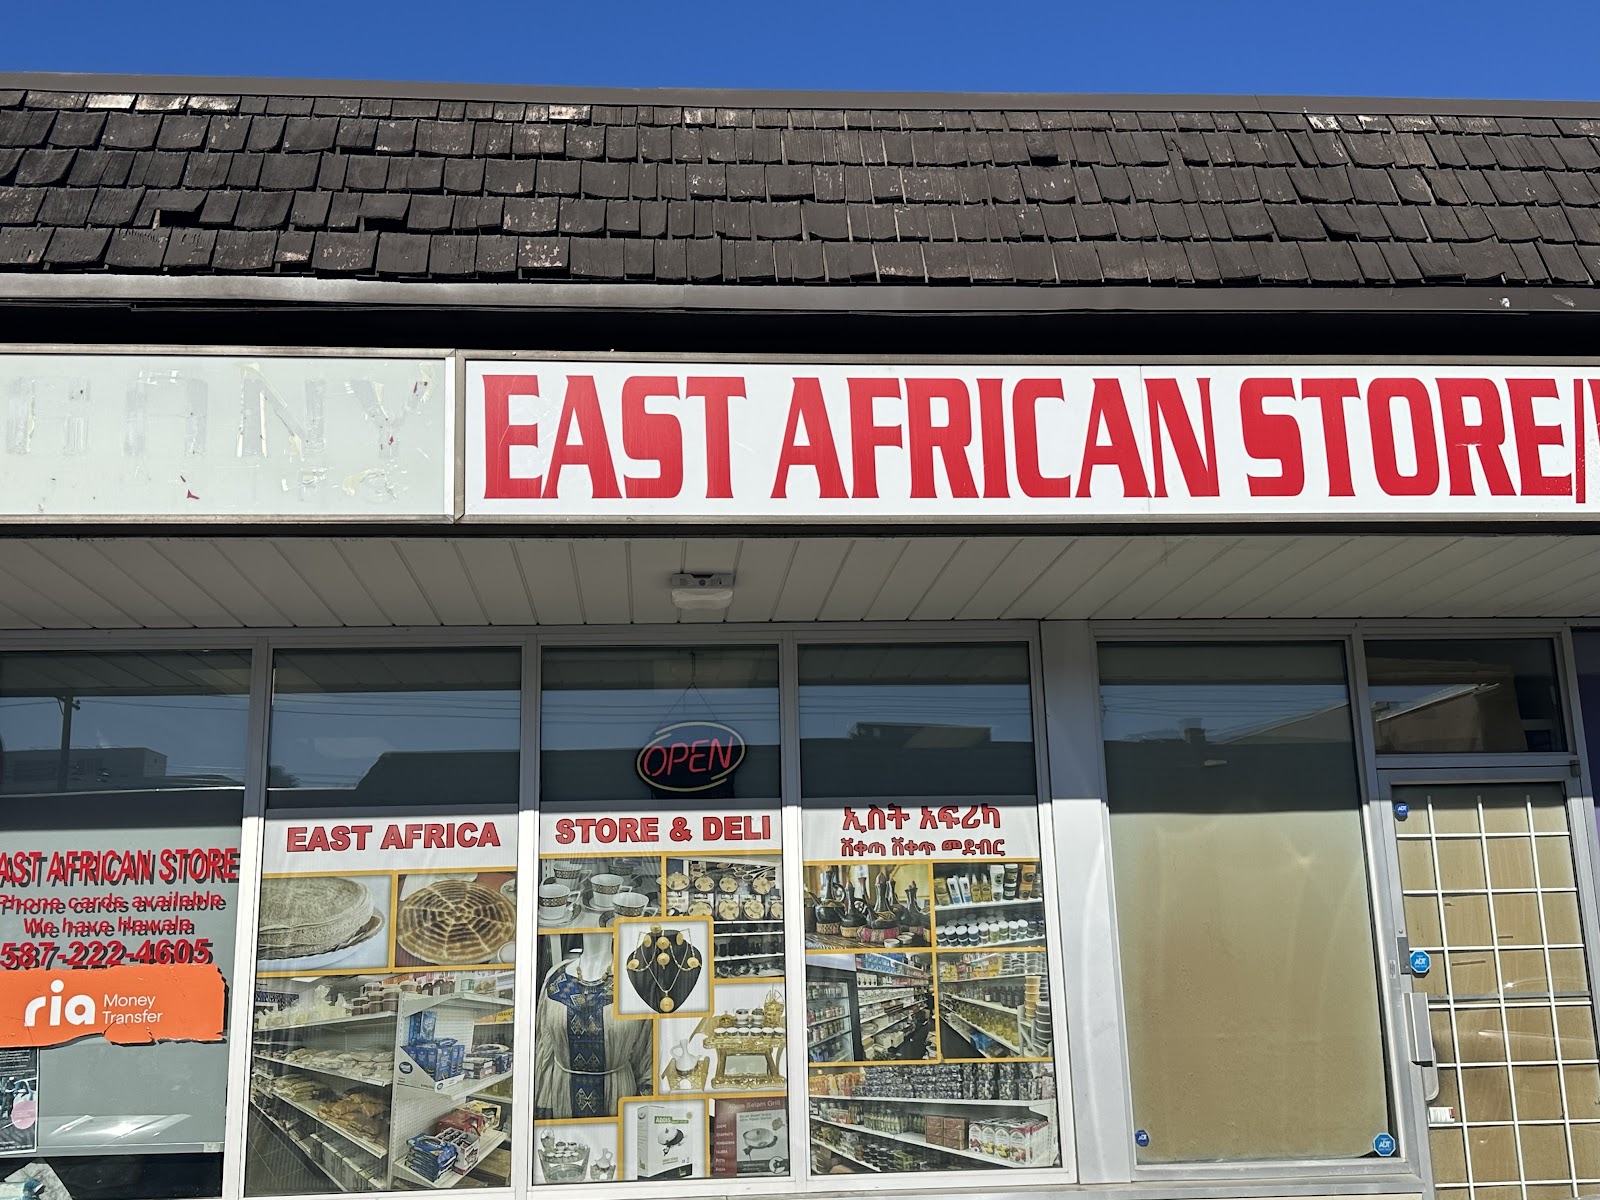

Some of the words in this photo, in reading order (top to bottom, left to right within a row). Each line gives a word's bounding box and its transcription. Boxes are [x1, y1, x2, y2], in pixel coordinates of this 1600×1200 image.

[483, 375, 746, 499] EAST
[771, 377, 1220, 498] AFRICAN
[643, 736, 734, 777] OPEN
[555, 817, 660, 844] STORE
[669, 816, 693, 842] &
[702, 815, 771, 842] DELI
[919, 803, 1001, 830] አፍሪካ
[286, 825, 373, 852] EAST
[380, 822, 501, 849] AFRICA
[0, 851, 42, 883] AST
[46, 849, 152, 883] AFRICAN
[158, 847, 238, 881] STORE
[0, 894, 61, 910] Phone
[68, 892, 125, 909] cards
[132, 891, 223, 907] available
[23, 917, 55, 934] We
[62, 917, 111, 933] have
[117, 915, 192, 932] Hawala
[0, 938, 211, 967] 587-222-4605
[1414, 956, 1427, 966] ADT
[24, 979, 96, 1027] ria
[104, 994, 156, 1009] Money
[102, 1010, 163, 1025] Transfer
[767, 1099, 781, 1107] Grill
[1378, 1139, 1391, 1149] ADT
